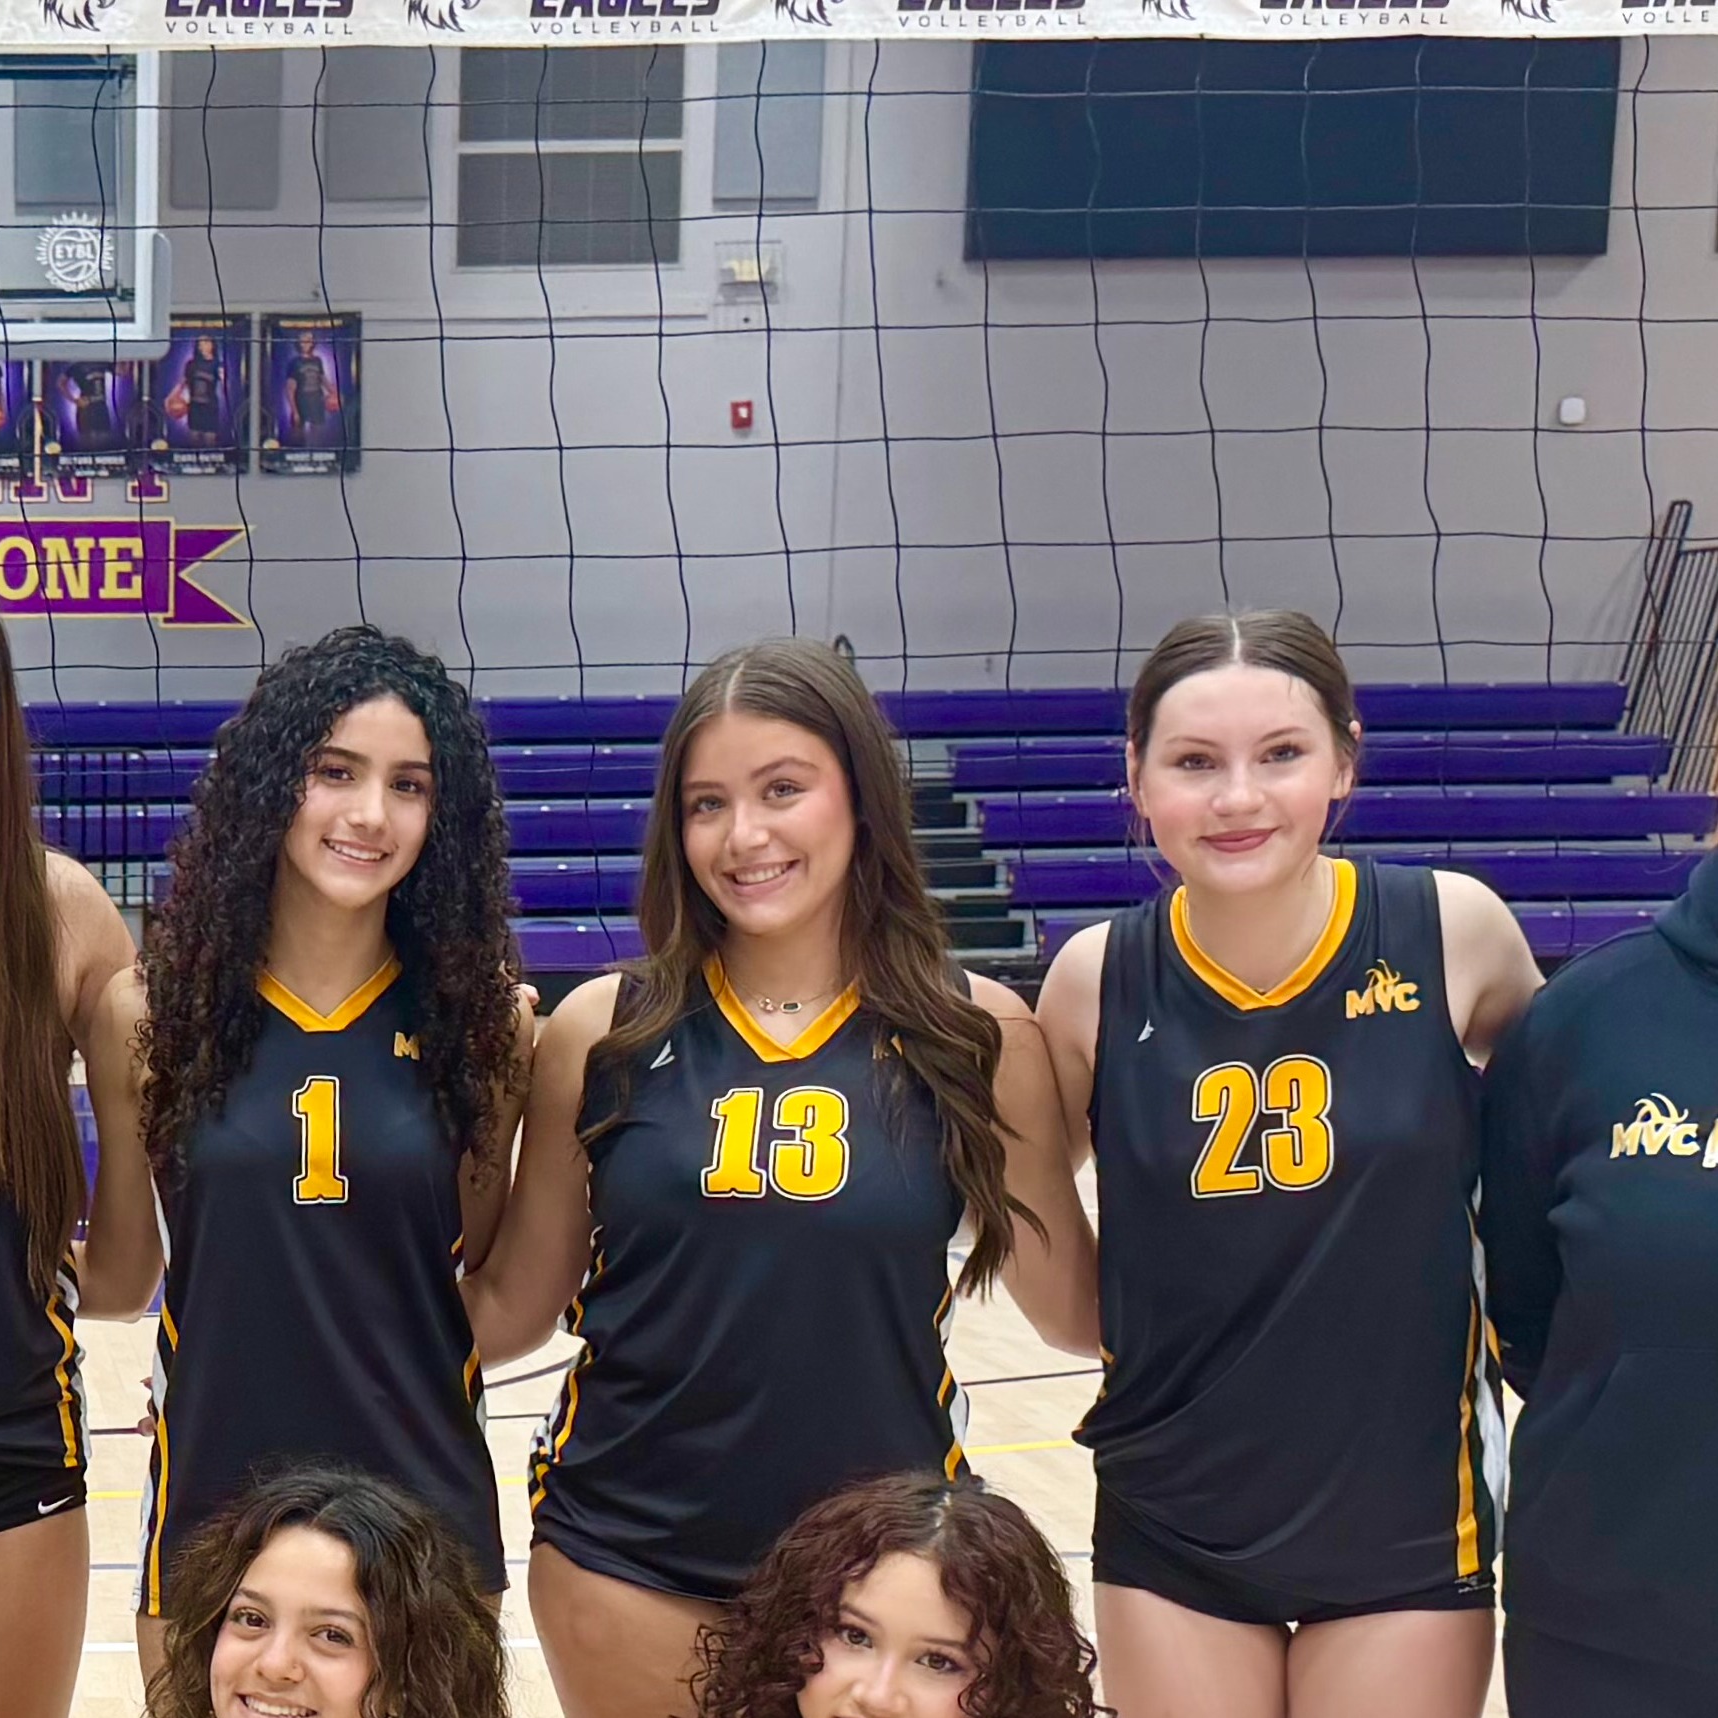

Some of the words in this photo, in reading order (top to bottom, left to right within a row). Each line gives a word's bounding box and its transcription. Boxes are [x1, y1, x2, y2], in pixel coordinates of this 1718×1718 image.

[165, 20, 355, 35] VOLLEYBALL
[530, 19, 720, 35] VOLLEYBALL
[899, 12, 1087, 28] VOLLEYBALL
[1263, 12, 1449, 27] VOLLEYBALL
[55, 243, 95, 259] EYBL
[1346, 983, 1421, 1019] MVC
[1190, 1052, 1335, 1199] 23
[291, 1075, 350, 1205] 1
[699, 1085, 851, 1201] 13
[1609, 1122, 1701, 1160] MVC
